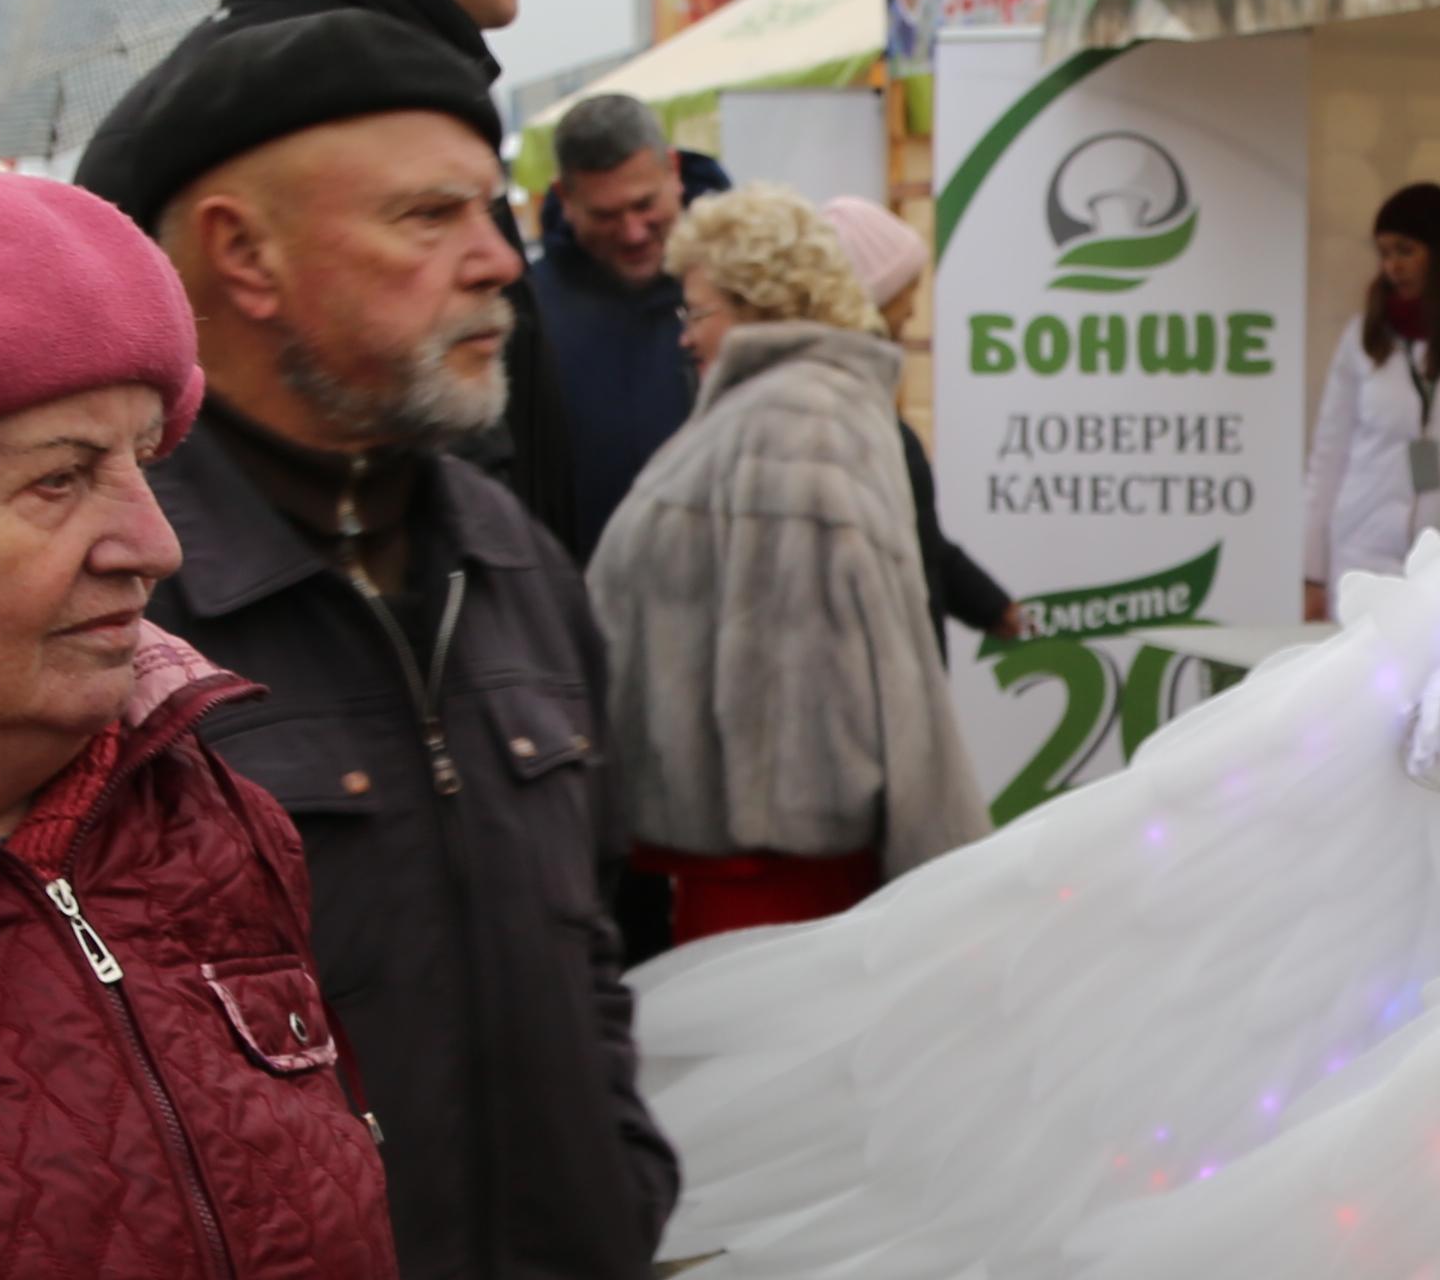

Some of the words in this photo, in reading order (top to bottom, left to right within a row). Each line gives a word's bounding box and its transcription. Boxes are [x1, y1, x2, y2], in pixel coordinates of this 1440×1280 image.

[966, 311, 1277, 377] БОНШЕ
[996, 413, 1245, 462] ДОВЕРИЕ
[986, 475, 1256, 517] КАЧЕСТВО
[1015, 582, 1192, 643] Вместе
